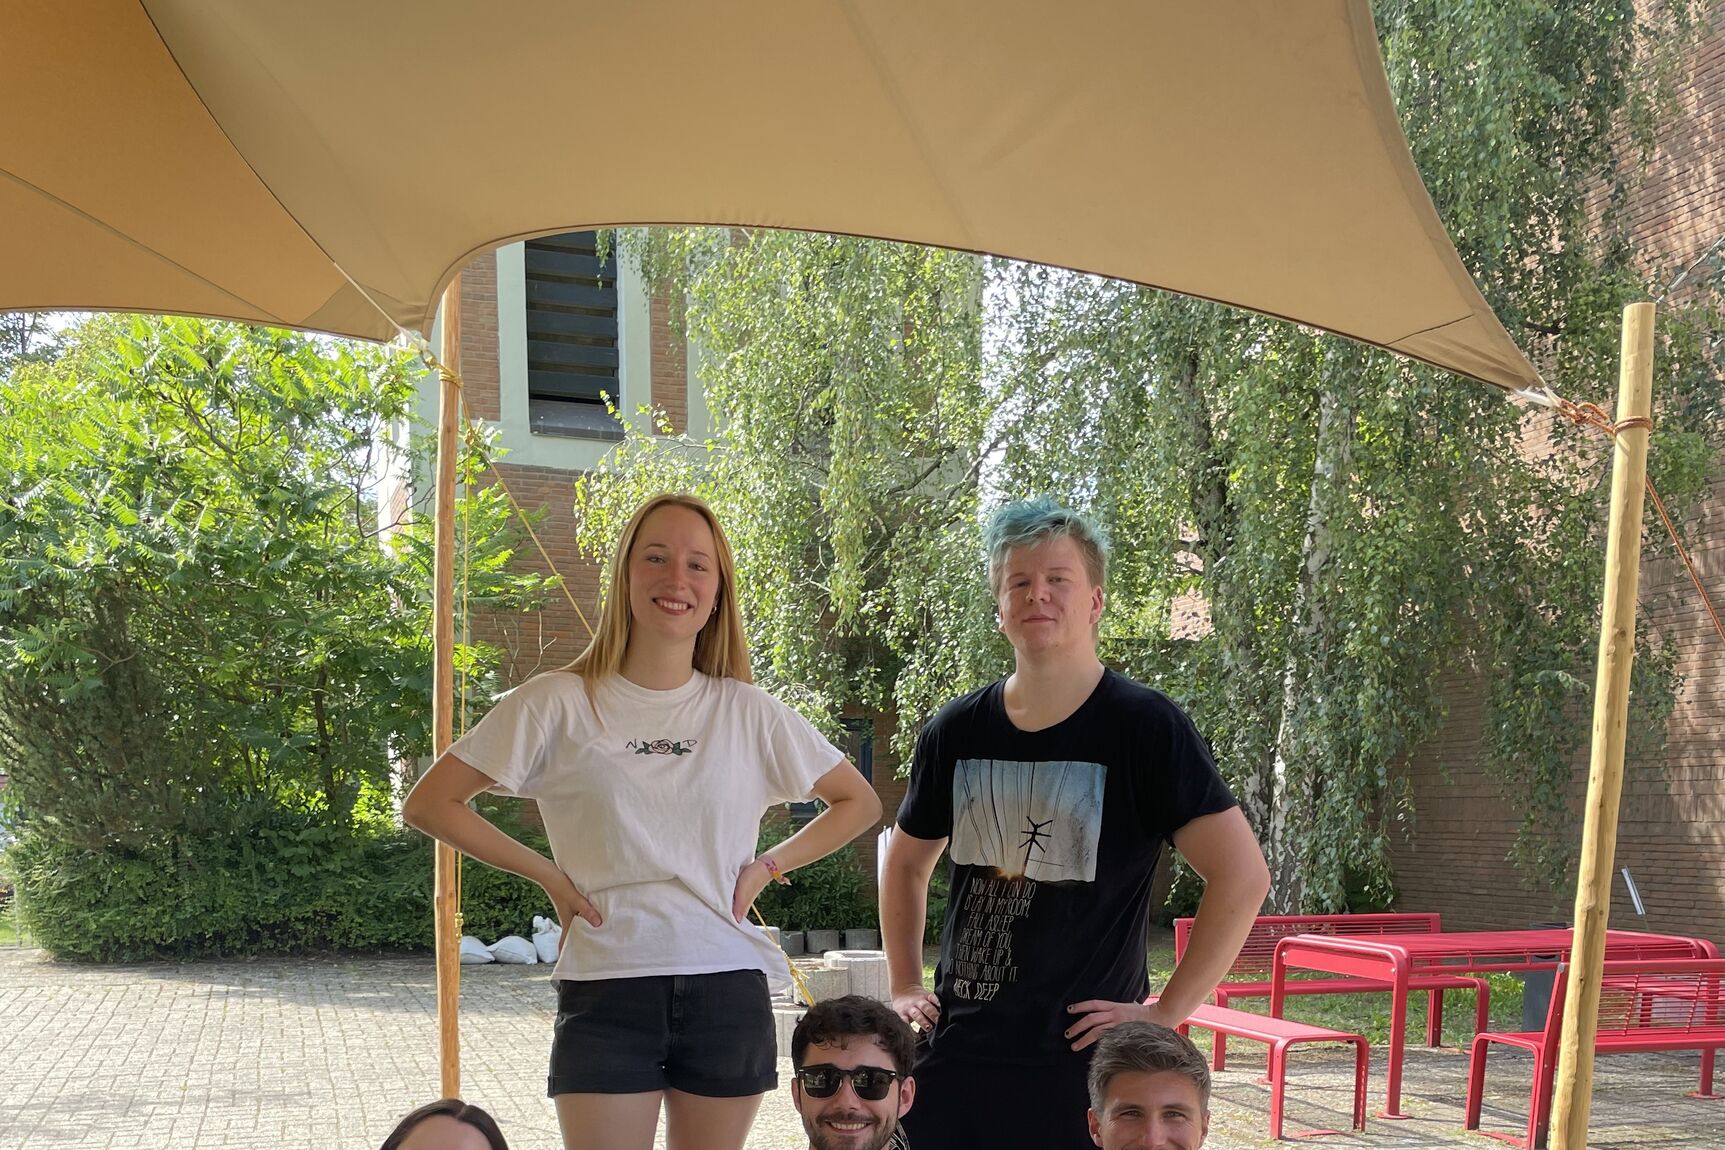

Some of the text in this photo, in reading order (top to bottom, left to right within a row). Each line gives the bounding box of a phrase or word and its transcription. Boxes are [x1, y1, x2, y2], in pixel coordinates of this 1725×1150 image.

[625, 738, 637, 749] N
[970, 877, 987, 895] NOW
[985, 879, 1000, 897] ALL
[1007, 880, 1022, 898] CAN
[1022, 881, 1037, 899] DO
[971, 895, 986, 912] LAY
[985, 896, 996, 914] IN
[994, 897, 1008, 915] MY
[967, 911, 1015, 932] FALL ASLEEP
[960, 928, 983, 946] DREAM
[983, 931, 995, 948] OF
[955, 943, 971, 961] THEN
[970, 946, 992, 964] WAKE
[993, 948, 1004, 965] UP
[955, 959, 980, 980] NOTHING
[980, 964, 1006, 982] ABOUT
[953, 978, 1000, 1001] NECK DEEP
